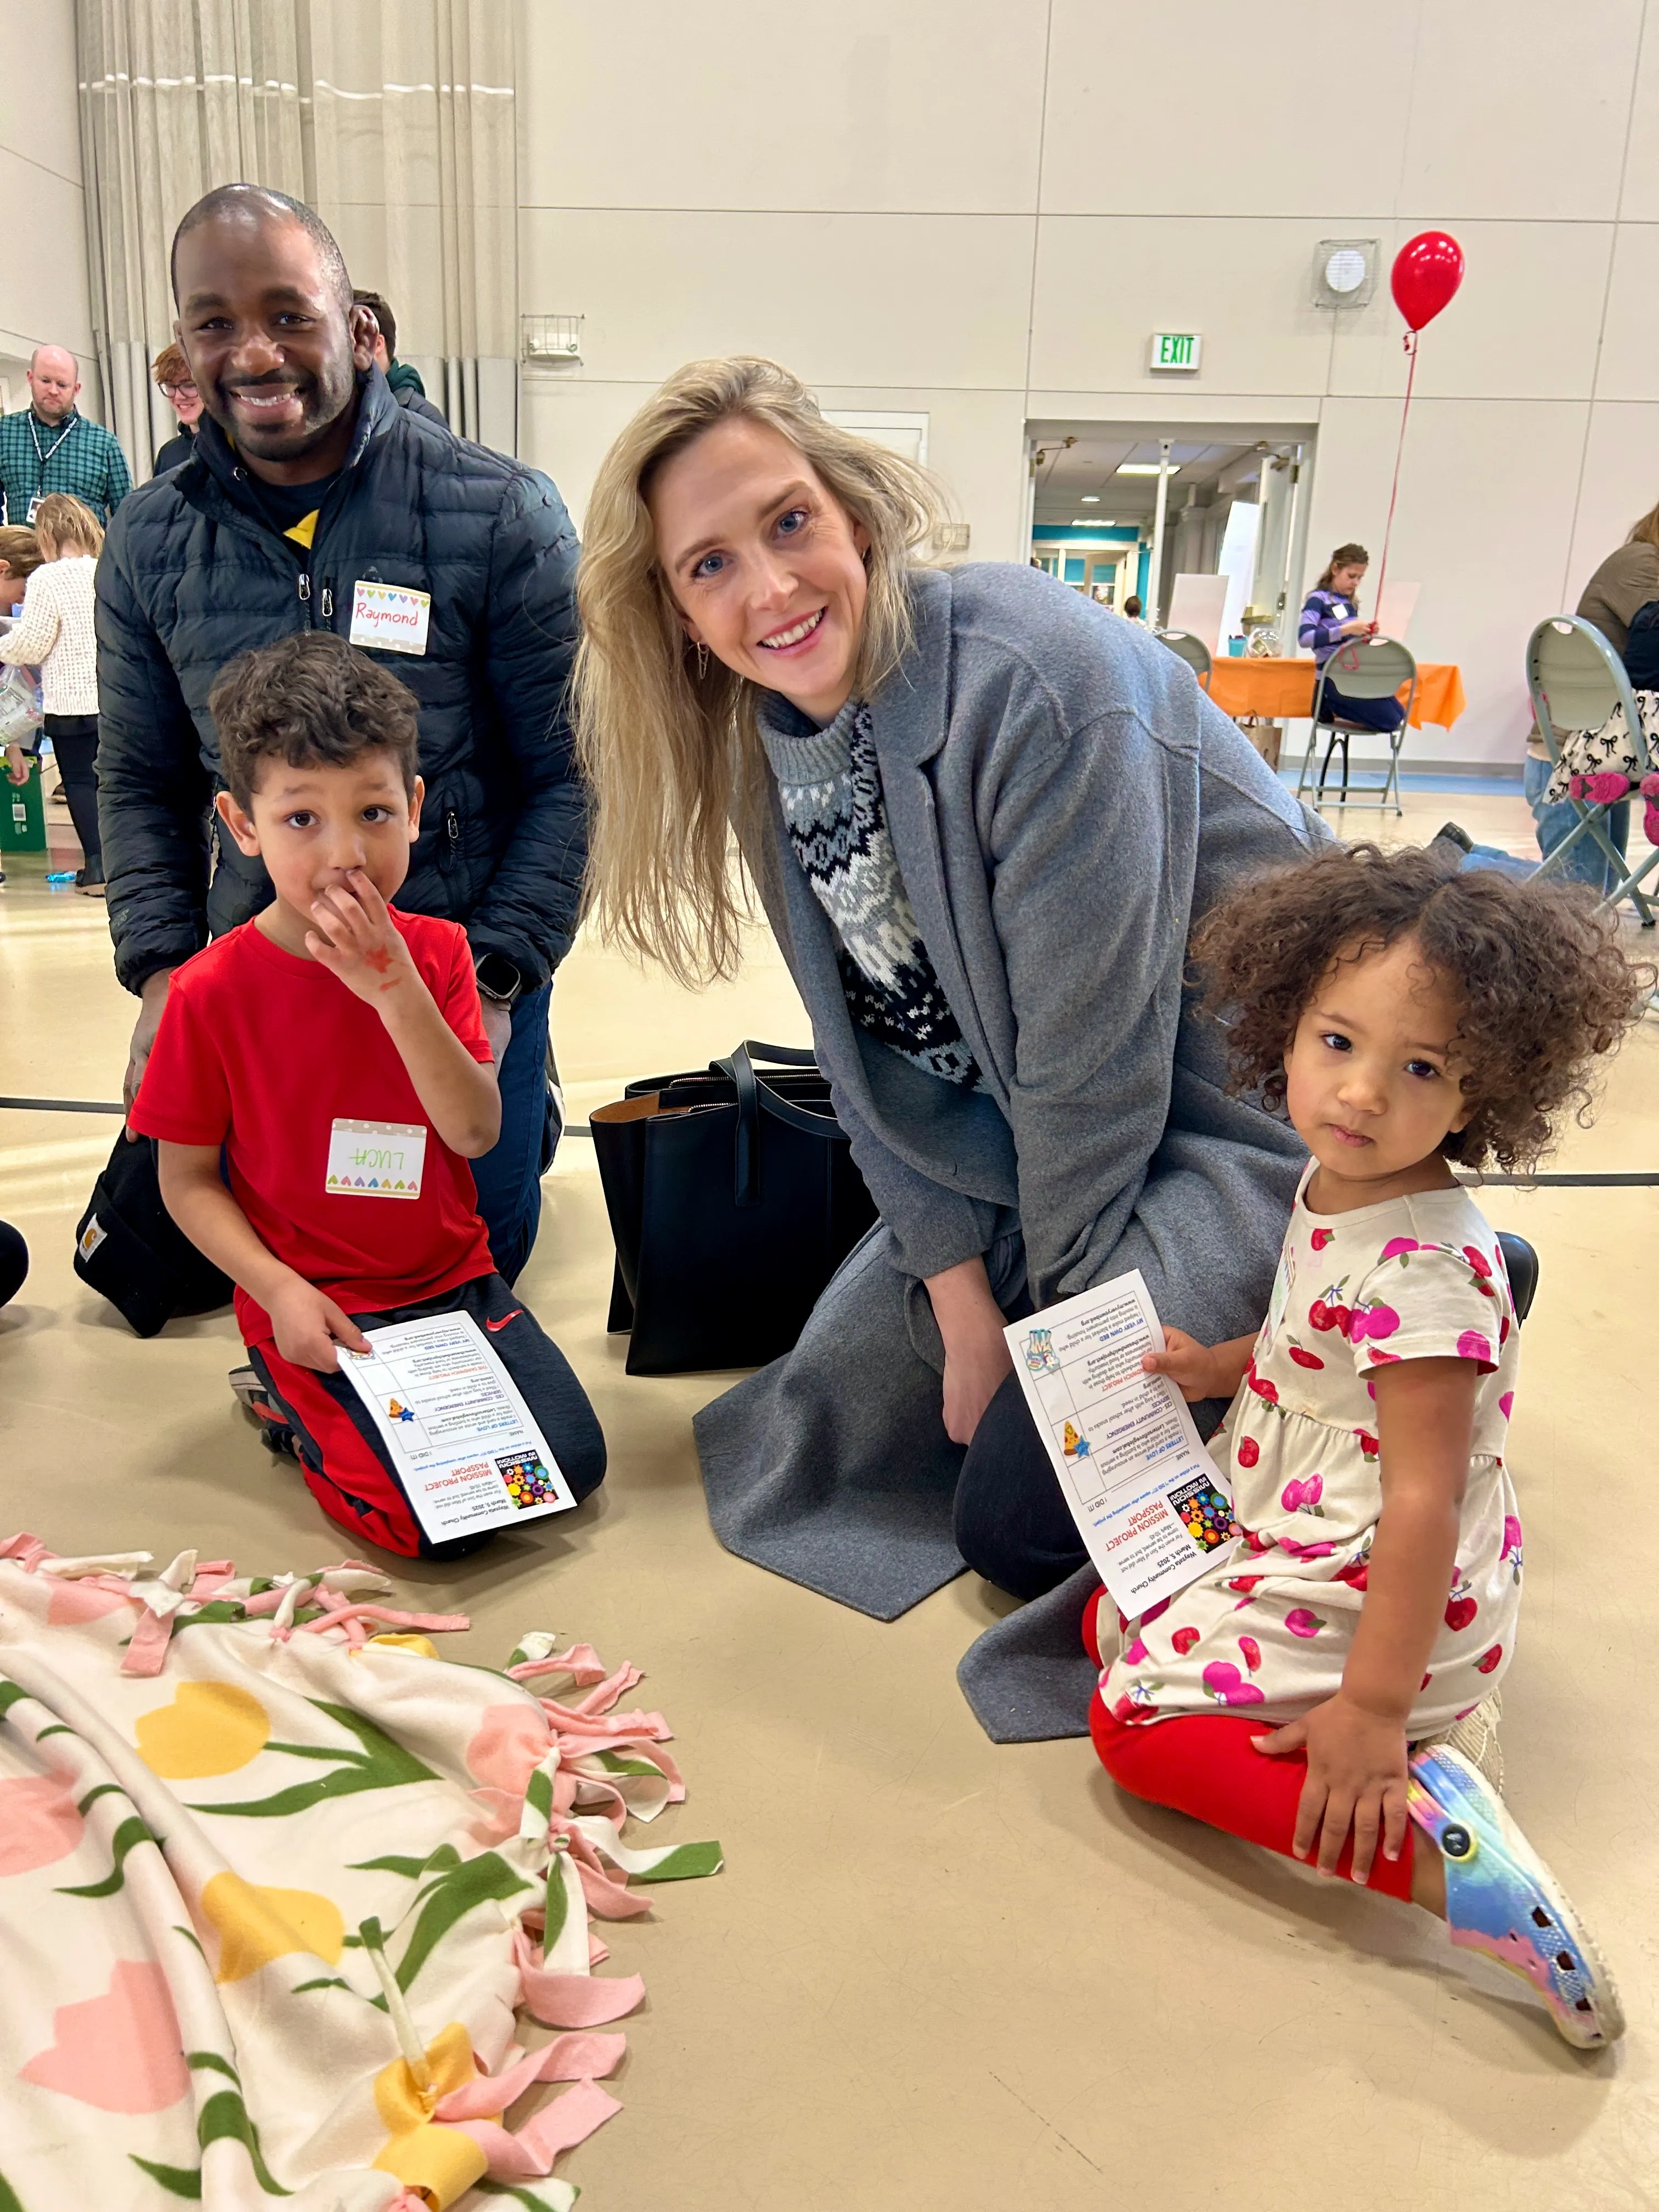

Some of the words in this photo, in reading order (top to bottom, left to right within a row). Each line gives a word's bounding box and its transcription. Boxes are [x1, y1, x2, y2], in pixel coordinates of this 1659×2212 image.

[1161, 336, 1194, 363] EXIT
[356, 602, 419, 628] Raymond
[1118, 1307, 1134, 1317] moving
[1124, 1313, 1139, 1322] helped
[1086, 1317, 1109, 1331] permanent
[1124, 1322, 1136, 1330] VERY
[1091, 1327, 1108, 1337] blanket
[1099, 1333, 1109, 1341] BED
[1110, 1328, 1123, 1336] OWN
[1069, 1339, 1080, 1348] child
[1109, 1357, 1120, 1365] food
[1120, 1362, 1141, 1374] sandwich
[1091, 1369, 1107, 1379] dealing
[1093, 1378, 1105, 1386] those
[1102, 1378, 1123, 1391] PROJECT
[1139, 1391, 1149, 1400] child
[1152, 1394, 1170, 1408] SERVICES
[1135, 1401, 1144, 1409] with
[1164, 1401, 1172, 1409] CES
[1108, 1412, 1122, 1423] school
[1136, 1407, 1163, 1424] COMMUNITY
[1093, 1419, 1108, 1429] snacks
[1107, 1421, 1135, 1439] EMERGENCY
[1167, 1430, 1179, 1439] made
[1150, 1434, 1160, 1442] child
[1155, 1438, 1164, 1448] card
[1165, 1436, 1184, 1449] LETTERS
[1119, 1444, 1137, 1458] battling
[1135, 1448, 1147, 1457] wrote
[1147, 1443, 1155, 1452] and
[496, 1453, 527, 1464] MOTION!
[1146, 1450, 1158, 1460] LOVE
[1176, 1449, 1190, 1460] NAME
[499, 1455, 538, 1469] MISSION
[1100, 1457, 1115, 1468] serious
[1102, 1458, 1128, 1475] encouraging
[452, 1462, 489, 1476] PASSPORT
[460, 1469, 492, 1481] MISSION
[1199, 1476, 1207, 1485] IN
[425, 1477, 458, 1491] PROJECT
[1170, 1481, 1198, 1501] MOTION!
[1172, 1481, 1210, 1505] MISSION
[1094, 1498, 1104, 1508] DID
[1112, 1503, 1131, 1515] completing
[1128, 1501, 1163, 1526] PASSPORT
[460, 1510, 488, 1520] Community
[1137, 1509, 1168, 1531] MISSION
[1106, 1527, 1137, 1551] PROJECT
[1149, 1531, 1161, 1540] 10:45
[1165, 1537, 1175, 1545] even
[1175, 1544, 1191, 1555] March
[1157, 1556, 1170, 1567] 2025
[1175, 1551, 1197, 1565] Wayzata
[1148, 1564, 1175, 1582] Community
[1131, 1581, 1148, 1594] Church
